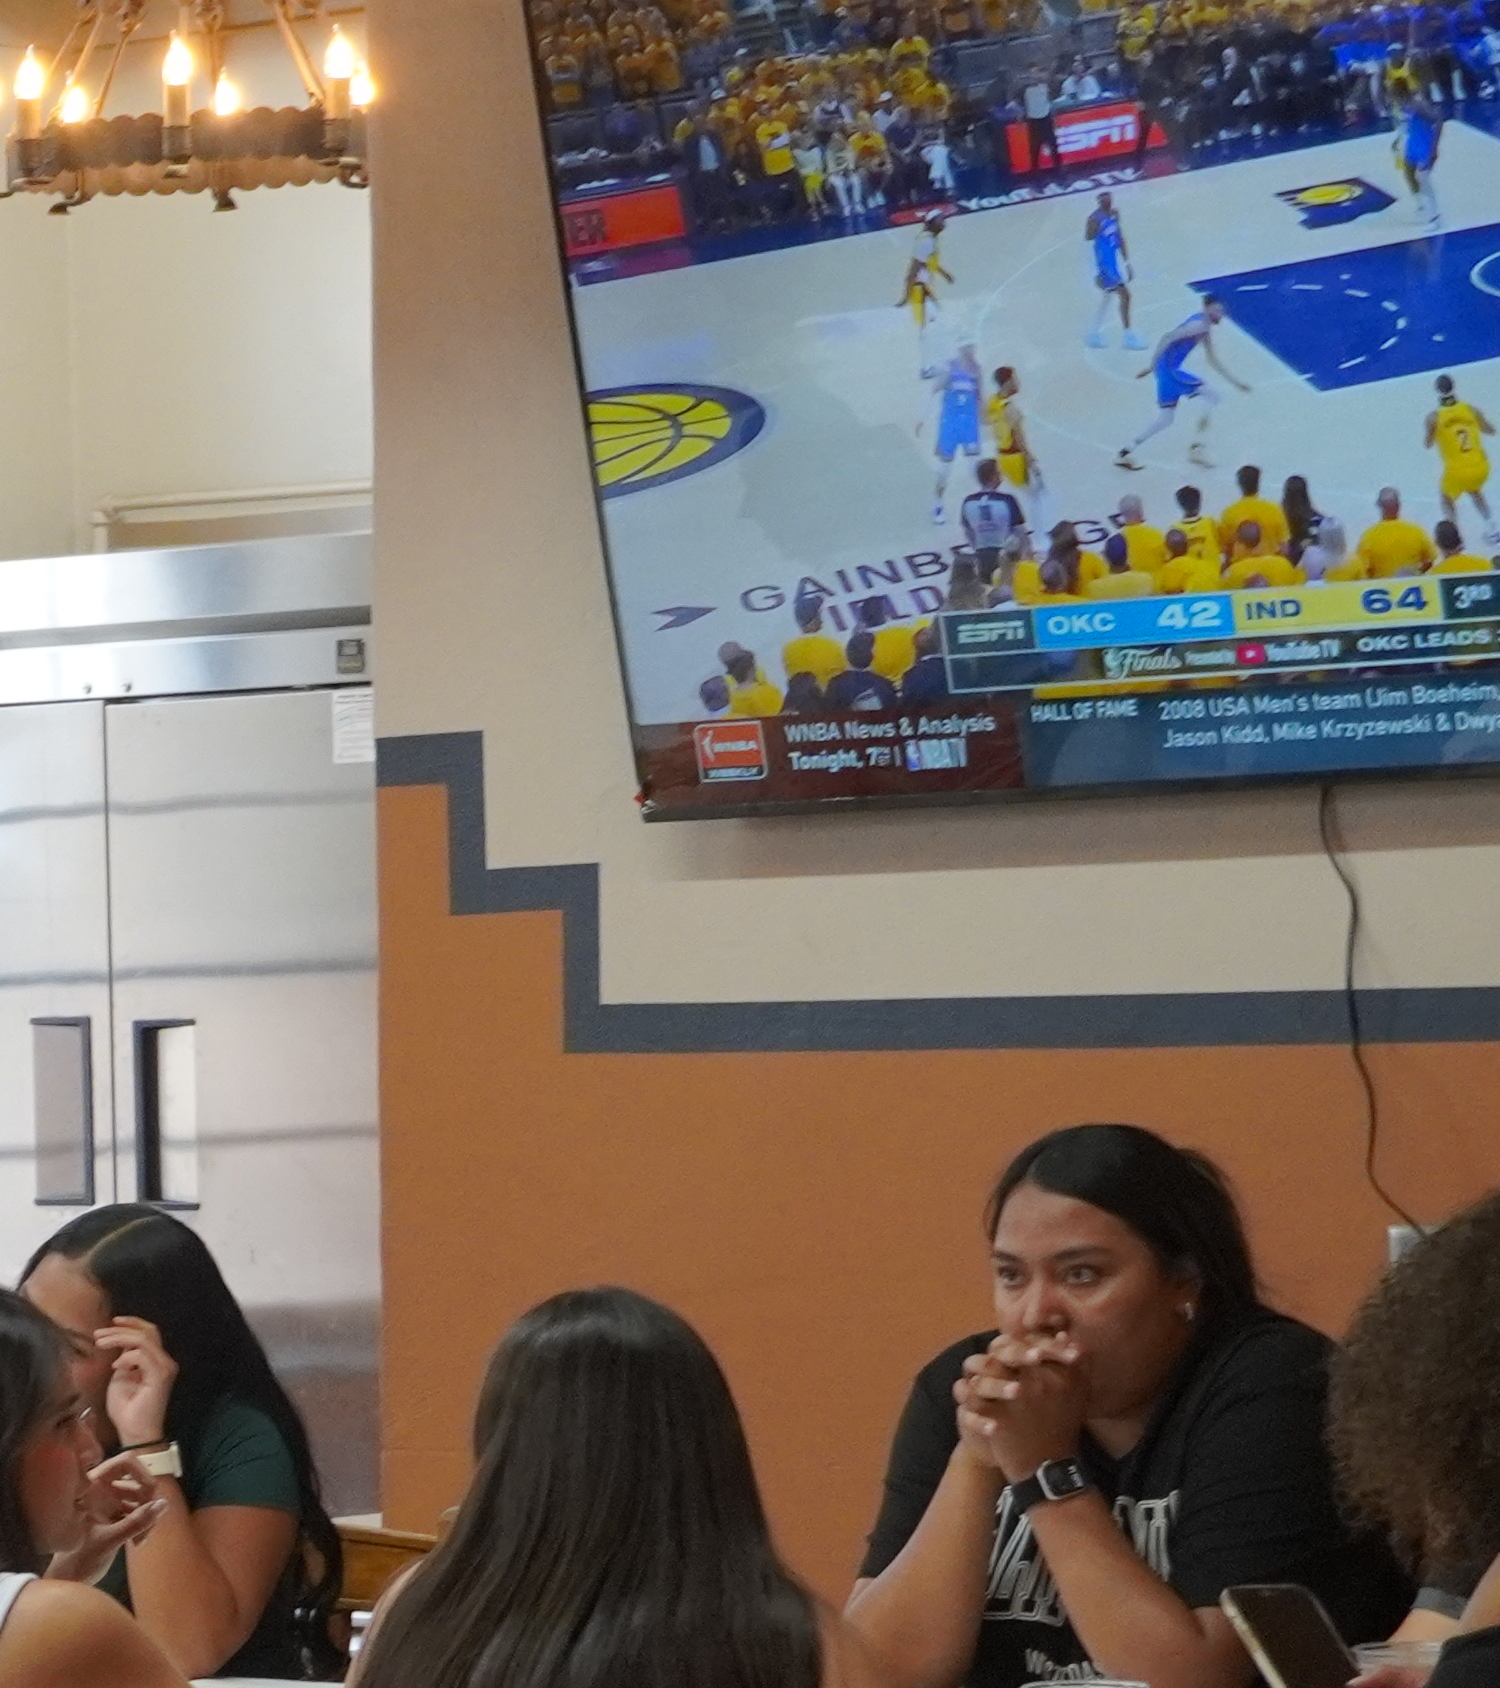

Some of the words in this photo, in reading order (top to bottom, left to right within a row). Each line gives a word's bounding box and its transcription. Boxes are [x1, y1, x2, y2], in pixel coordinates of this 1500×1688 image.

[957, 620, 1025, 644] ESPN
[1047, 613, 1116, 635] OKC
[1157, 600, 1222, 629] 42
[1246, 600, 1301, 620] IND
[1360, 586, 1428, 614] 64
[1357, 634, 1409, 652] OKC
[1413, 628, 1491, 649] LEADS
[1030, 702, 1072, 723] HALL
[1073, 701, 1094, 720] OF
[1095, 698, 1139, 718] FAME
[1158, 698, 1204, 721] 2008
[1209, 696, 1250, 717] USA
[1253, 694, 1310, 714] Men's
[1312, 691, 1362, 712] team
[784, 721, 841, 743] WNBA
[845, 719, 897, 740] News
[900, 717, 914, 736] &
[916, 713, 996, 736] Analysis
[1163, 728, 1218, 748] Jason
[1220, 722, 1271, 744] Kidd,
[1272, 720, 1318, 742] Mike
[1320, 714, 1432, 741] Krzyzewski
[1434, 711, 1451, 732] &
[787, 747, 864, 773] Tonight,
